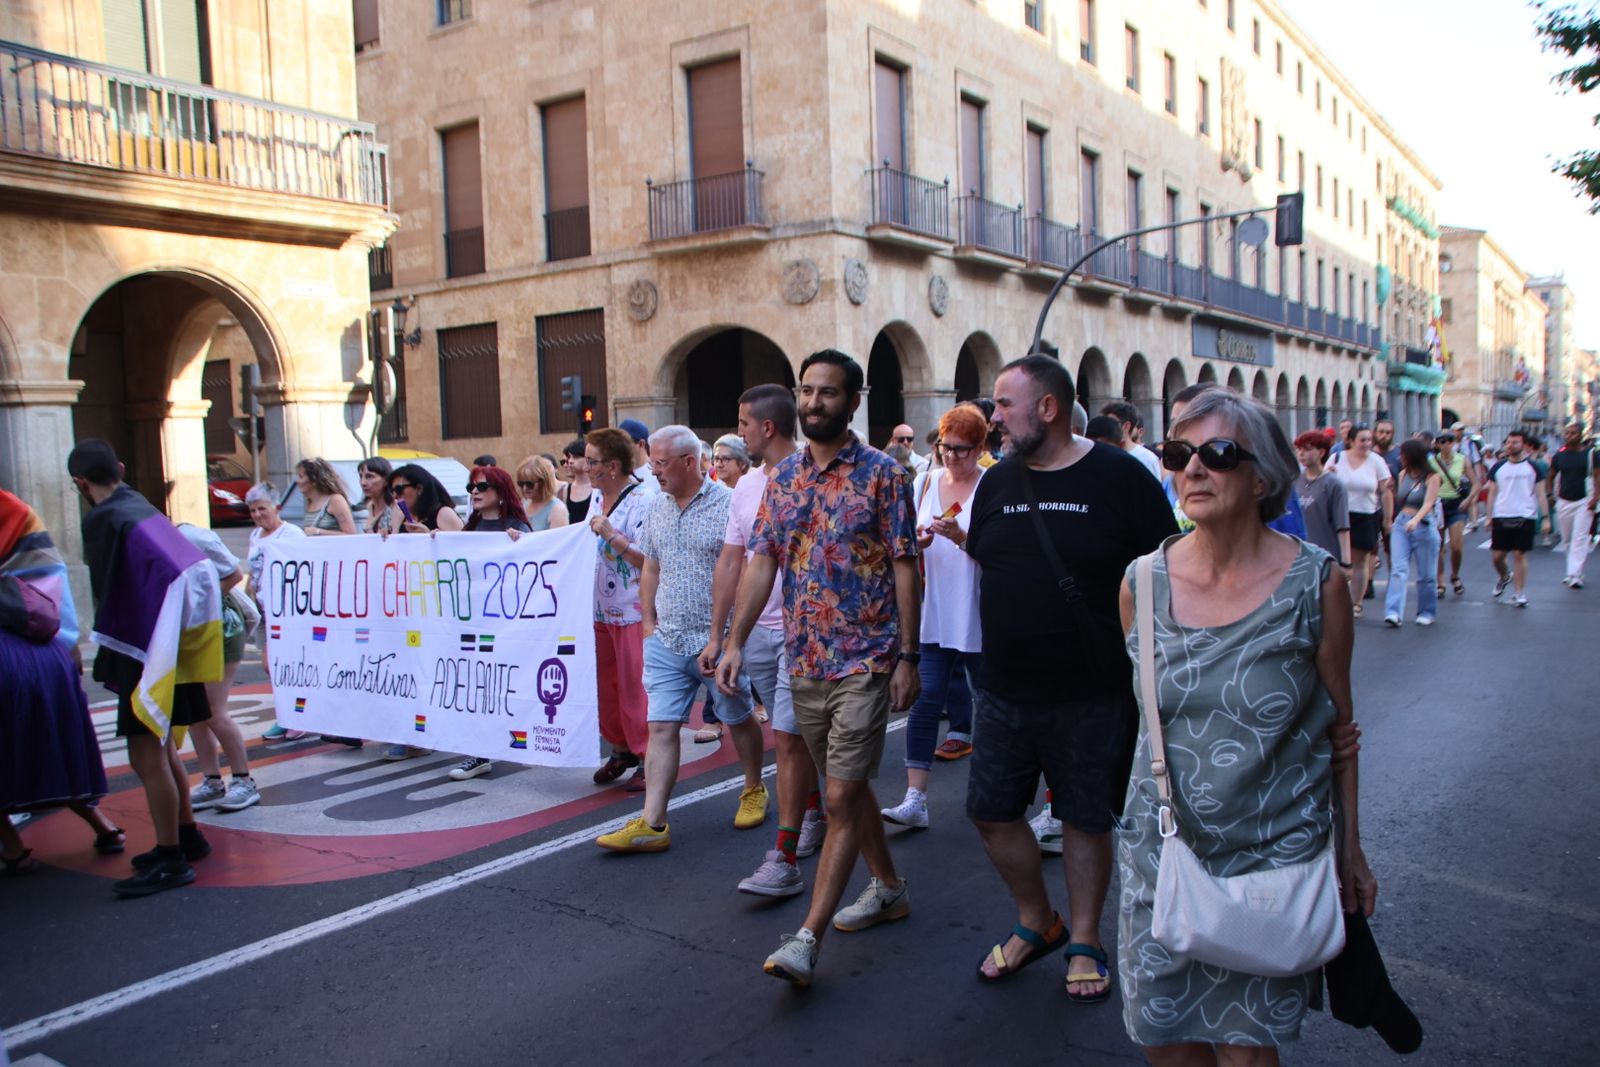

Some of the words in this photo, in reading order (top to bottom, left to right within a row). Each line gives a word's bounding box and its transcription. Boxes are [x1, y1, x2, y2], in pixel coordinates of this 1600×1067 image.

[1003, 505, 1015, 514] HA
[1039, 502, 1090, 513] HORRIBLE
[271, 559, 369, 618] ORGULLO
[383, 558, 471, 621] CHARRO
[482, 559, 558, 620] 2025
[429, 657, 520, 717] ADELANTE
